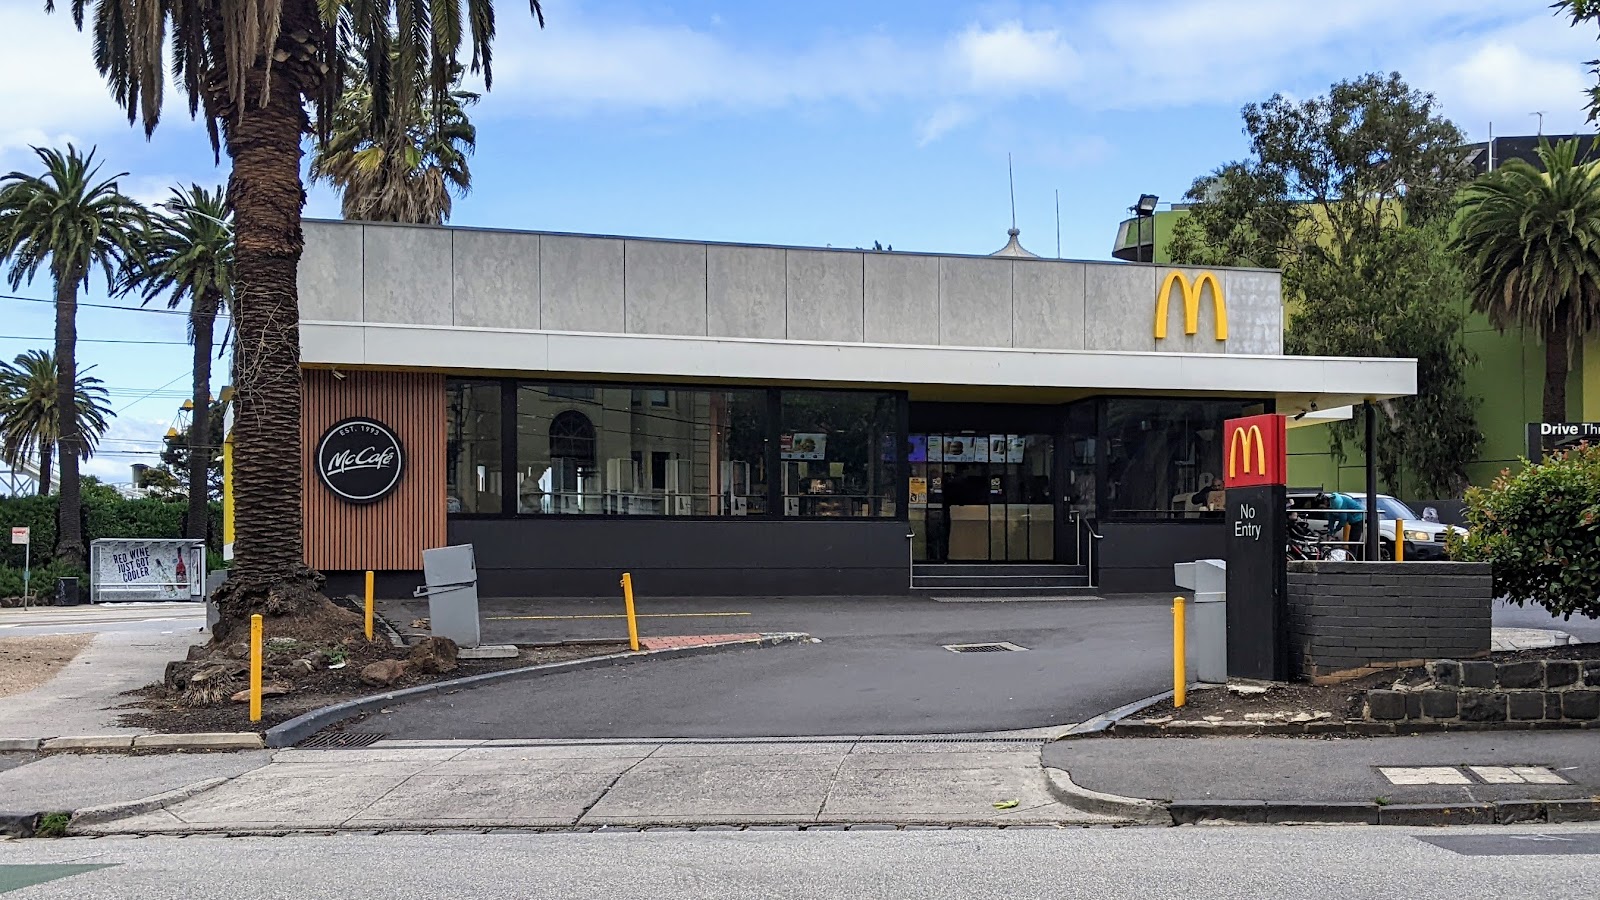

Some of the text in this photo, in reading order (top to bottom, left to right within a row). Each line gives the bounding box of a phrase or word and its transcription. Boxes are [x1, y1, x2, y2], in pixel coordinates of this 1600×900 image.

[339, 425, 379, 436] EST. 1993
[1541, 423, 1578, 435] Drive
[327, 446, 395, 474] McCafé
[1240, 504, 1256, 519] No
[1234, 522, 1261, 540] Entry
[113, 547, 151, 564] RED WINE
[118, 556, 150, 573] JUST GOT
[122, 566, 150, 583] COOLER
